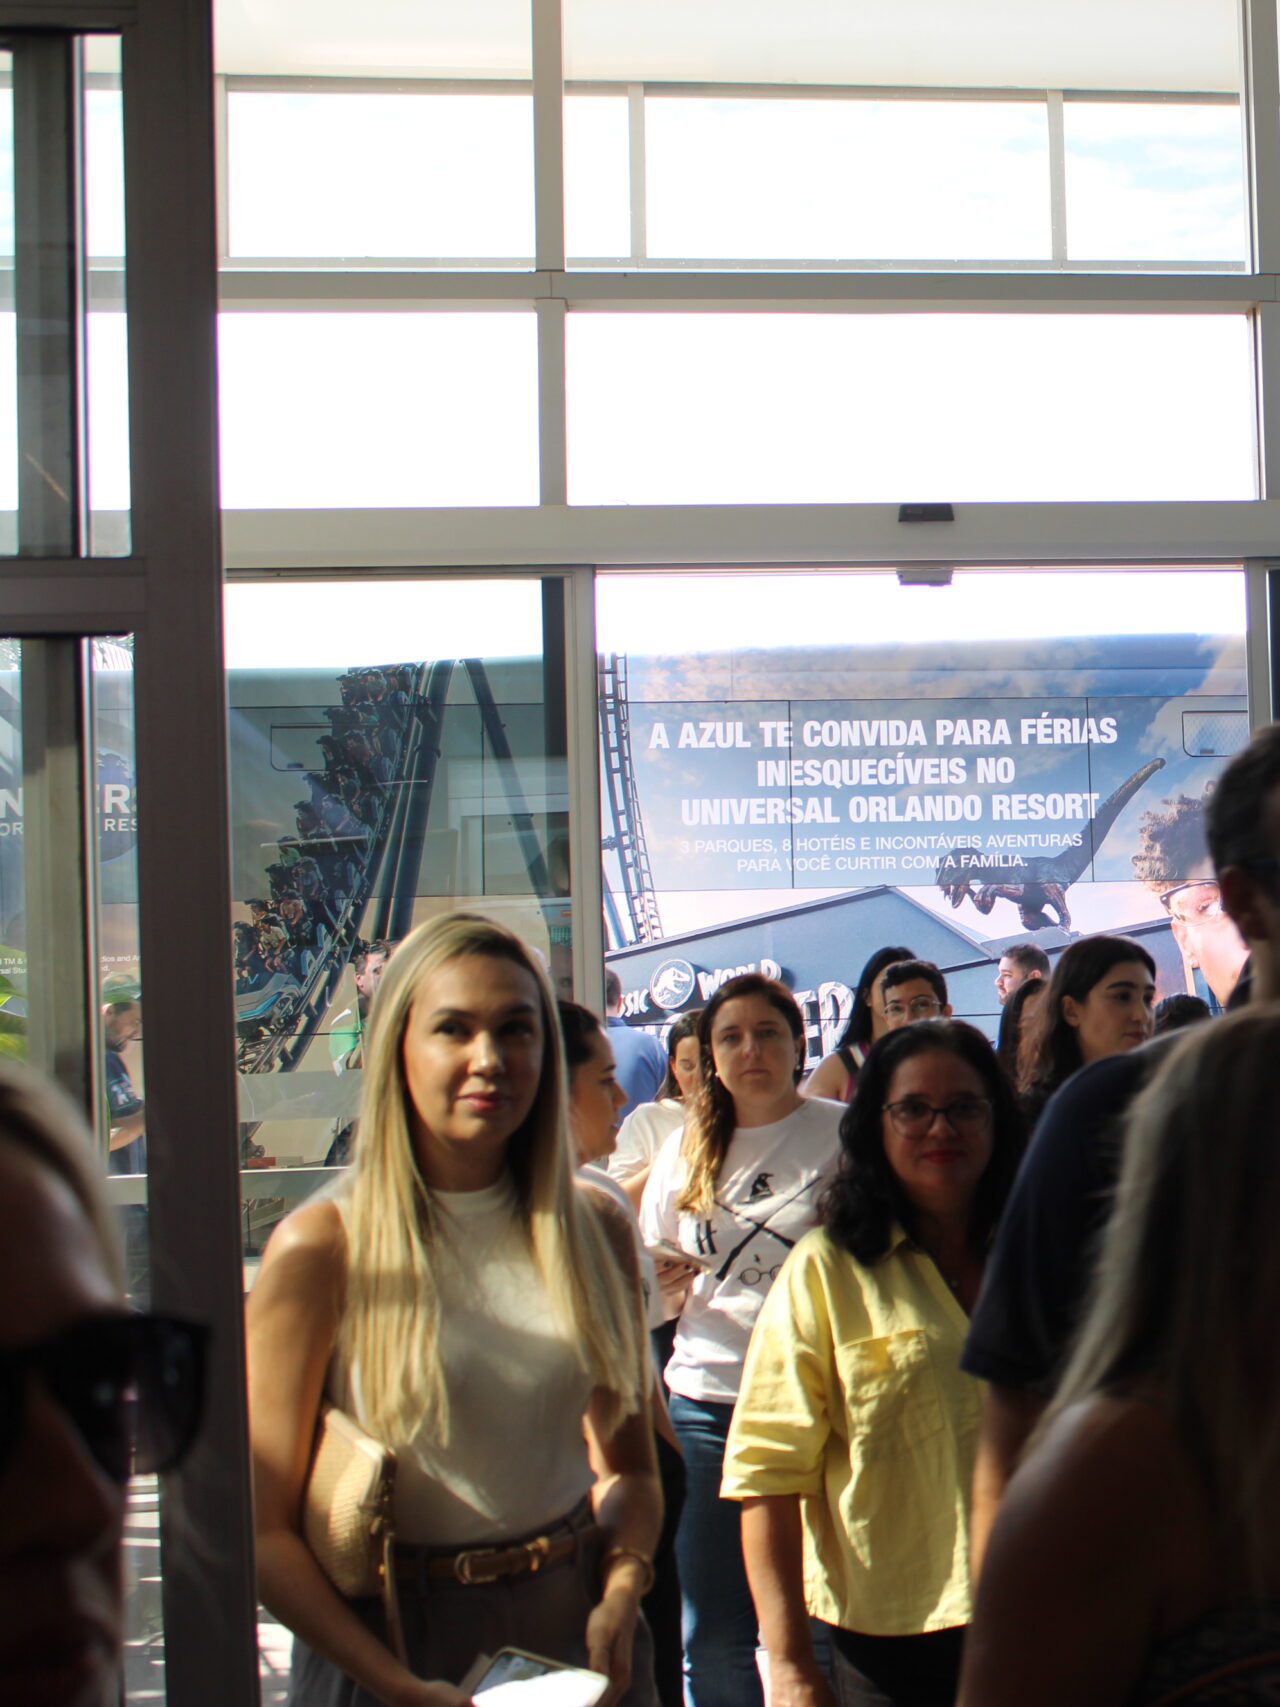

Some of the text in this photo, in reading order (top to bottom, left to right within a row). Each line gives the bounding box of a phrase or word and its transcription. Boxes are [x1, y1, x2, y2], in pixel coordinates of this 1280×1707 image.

[649, 712, 1118, 749] A AZUL TE CONVIDA PARA FÉRIAS
[757, 752, 1016, 789] INESQUECÍVEIS NO
[681, 792, 1100, 826] UNIVERSAL ORLANDO RESORT
[680, 832, 1083, 854] 3 PARQUES, 8 HOTÉIS E INCONTÁVEIS AVENTURAS
[737, 851, 1028, 872] PARA VOCÊ CURTIR COM A FAMÍLIA.
